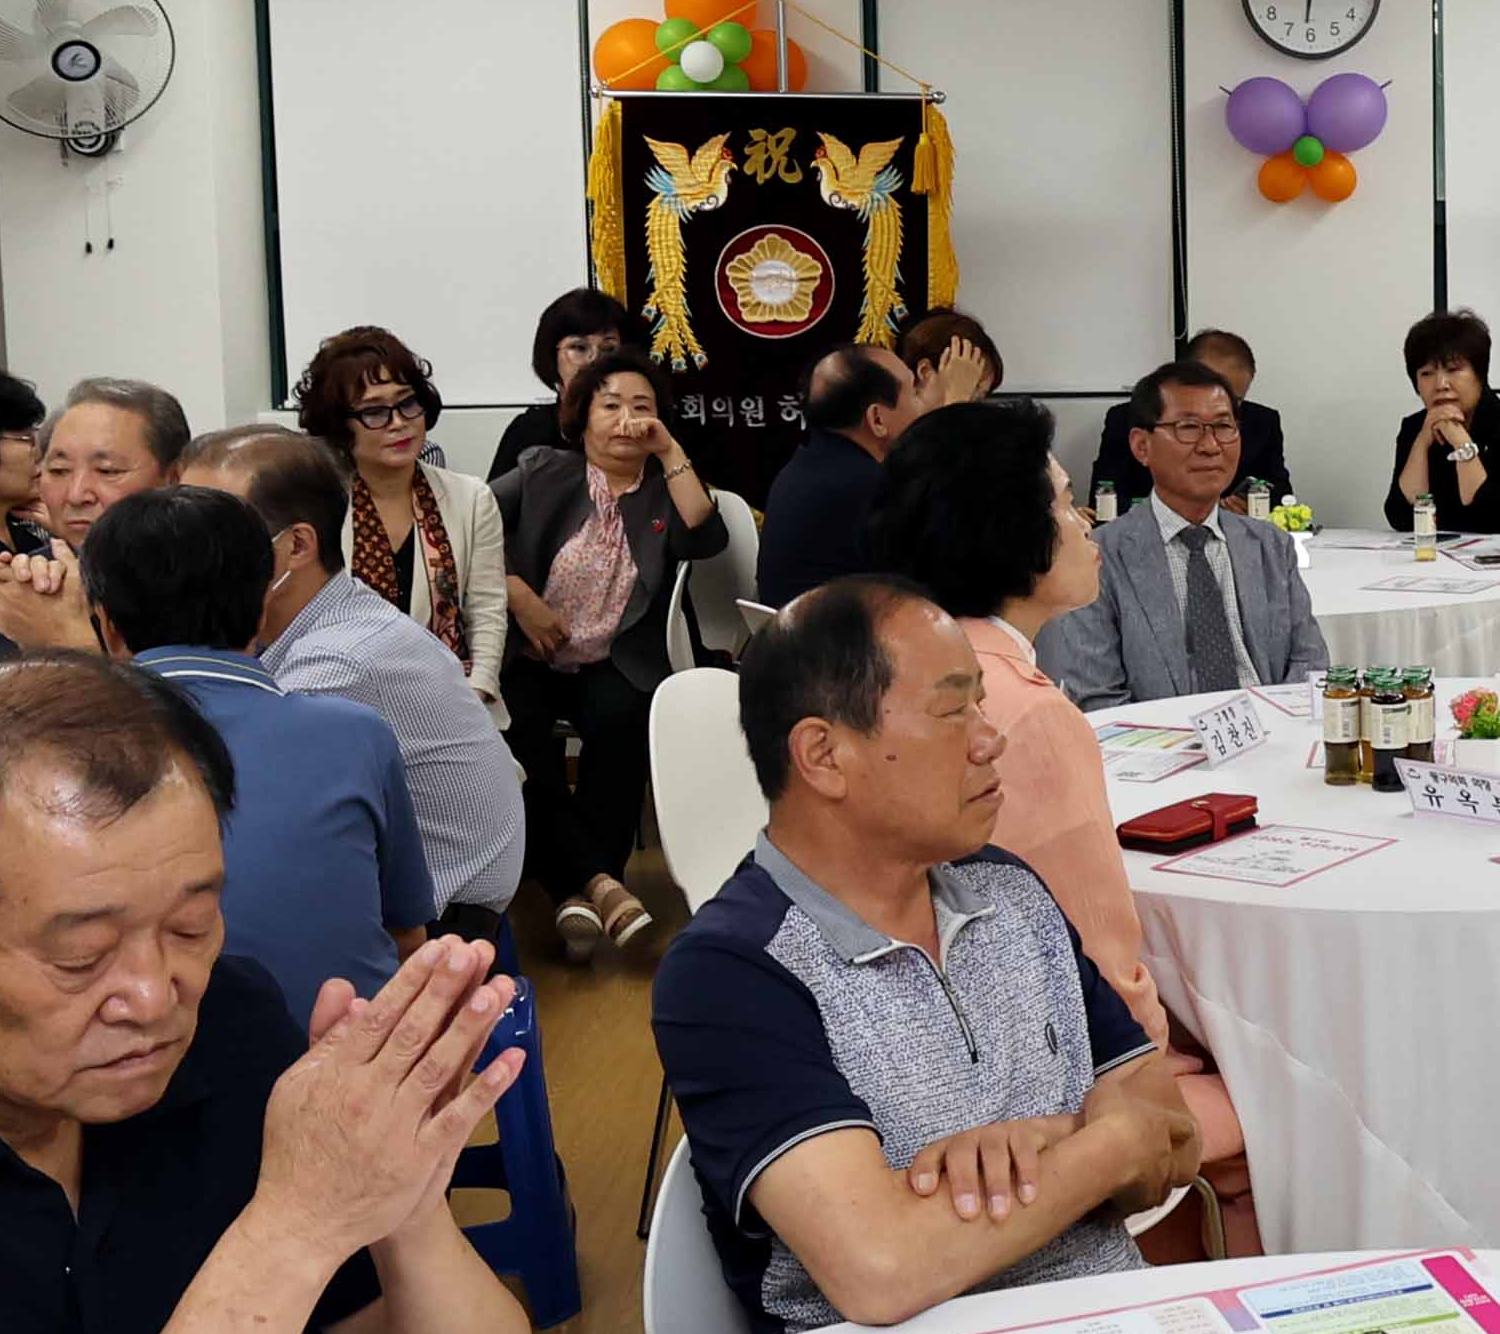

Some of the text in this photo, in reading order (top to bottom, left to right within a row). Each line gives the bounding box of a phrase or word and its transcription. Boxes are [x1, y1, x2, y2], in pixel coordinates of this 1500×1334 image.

[1267, 6, 1277, 20] 8
[1346, 8, 1355, 21] 4
[1284, 23, 1295, 36] 7
[1305, 28, 1315, 42] 6
[1330, 22, 1340, 36] 5
[743, 127, 803, 185] 祝
[676, 394, 767, 427] 회의원
